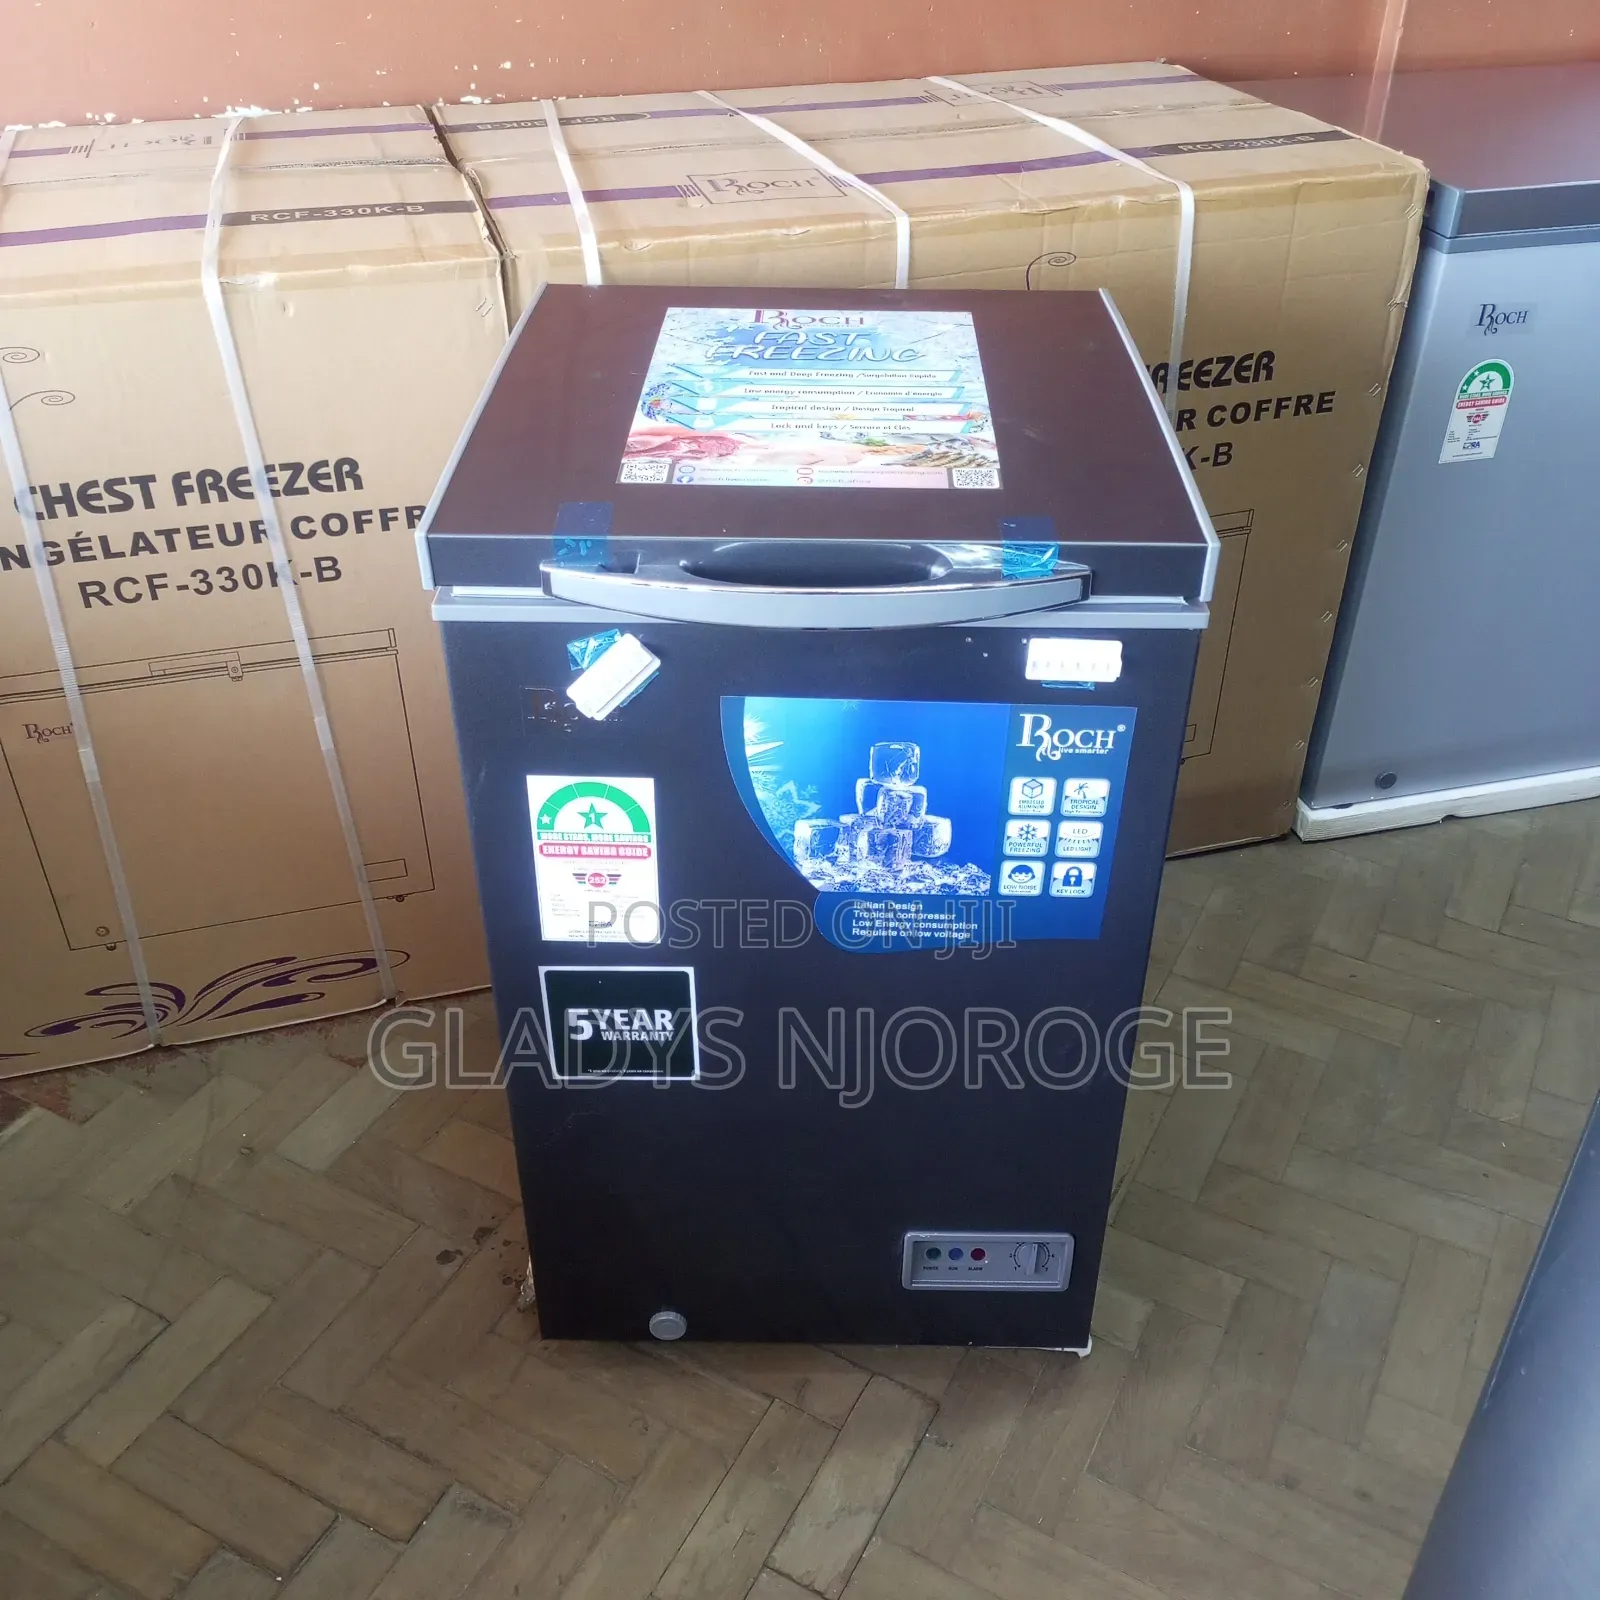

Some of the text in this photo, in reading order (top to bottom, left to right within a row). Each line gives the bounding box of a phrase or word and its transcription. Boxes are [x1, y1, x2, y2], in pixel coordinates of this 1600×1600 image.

[476, 115, 617, 131] RCF-30K-B
[1178, 136, 1316, 152] RCF-330K-B
[251, 205, 425, 222] RCF-330K-B
[753, 331, 871, 346] FAST
[705, 344, 927, 363] FREEZING
[1147, 350, 1276, 394] REEZER
[1206, 391, 1336, 429] COFFRE
[171, 457, 364, 507] FREEZER
[290, 504, 427, 540] COFFR
[78, 556, 342, 609] RCF-330K-B
[543, 845, 649, 857] ENERGY SAVING GUIDE
[589, 876, 606, 884] 252
[853, 901, 923, 912] Italian Design
[853, 910, 956, 920] Tropical compressor
[852, 928, 897, 938] Regulate
[934, 930, 971, 939] voltage
[875, 920, 911, 930] Energy
[913, 921, 978, 931] consumption
[568, 1008, 674, 1041] 5 YEAR
[601, 1031, 674, 1042] WARRANTY
